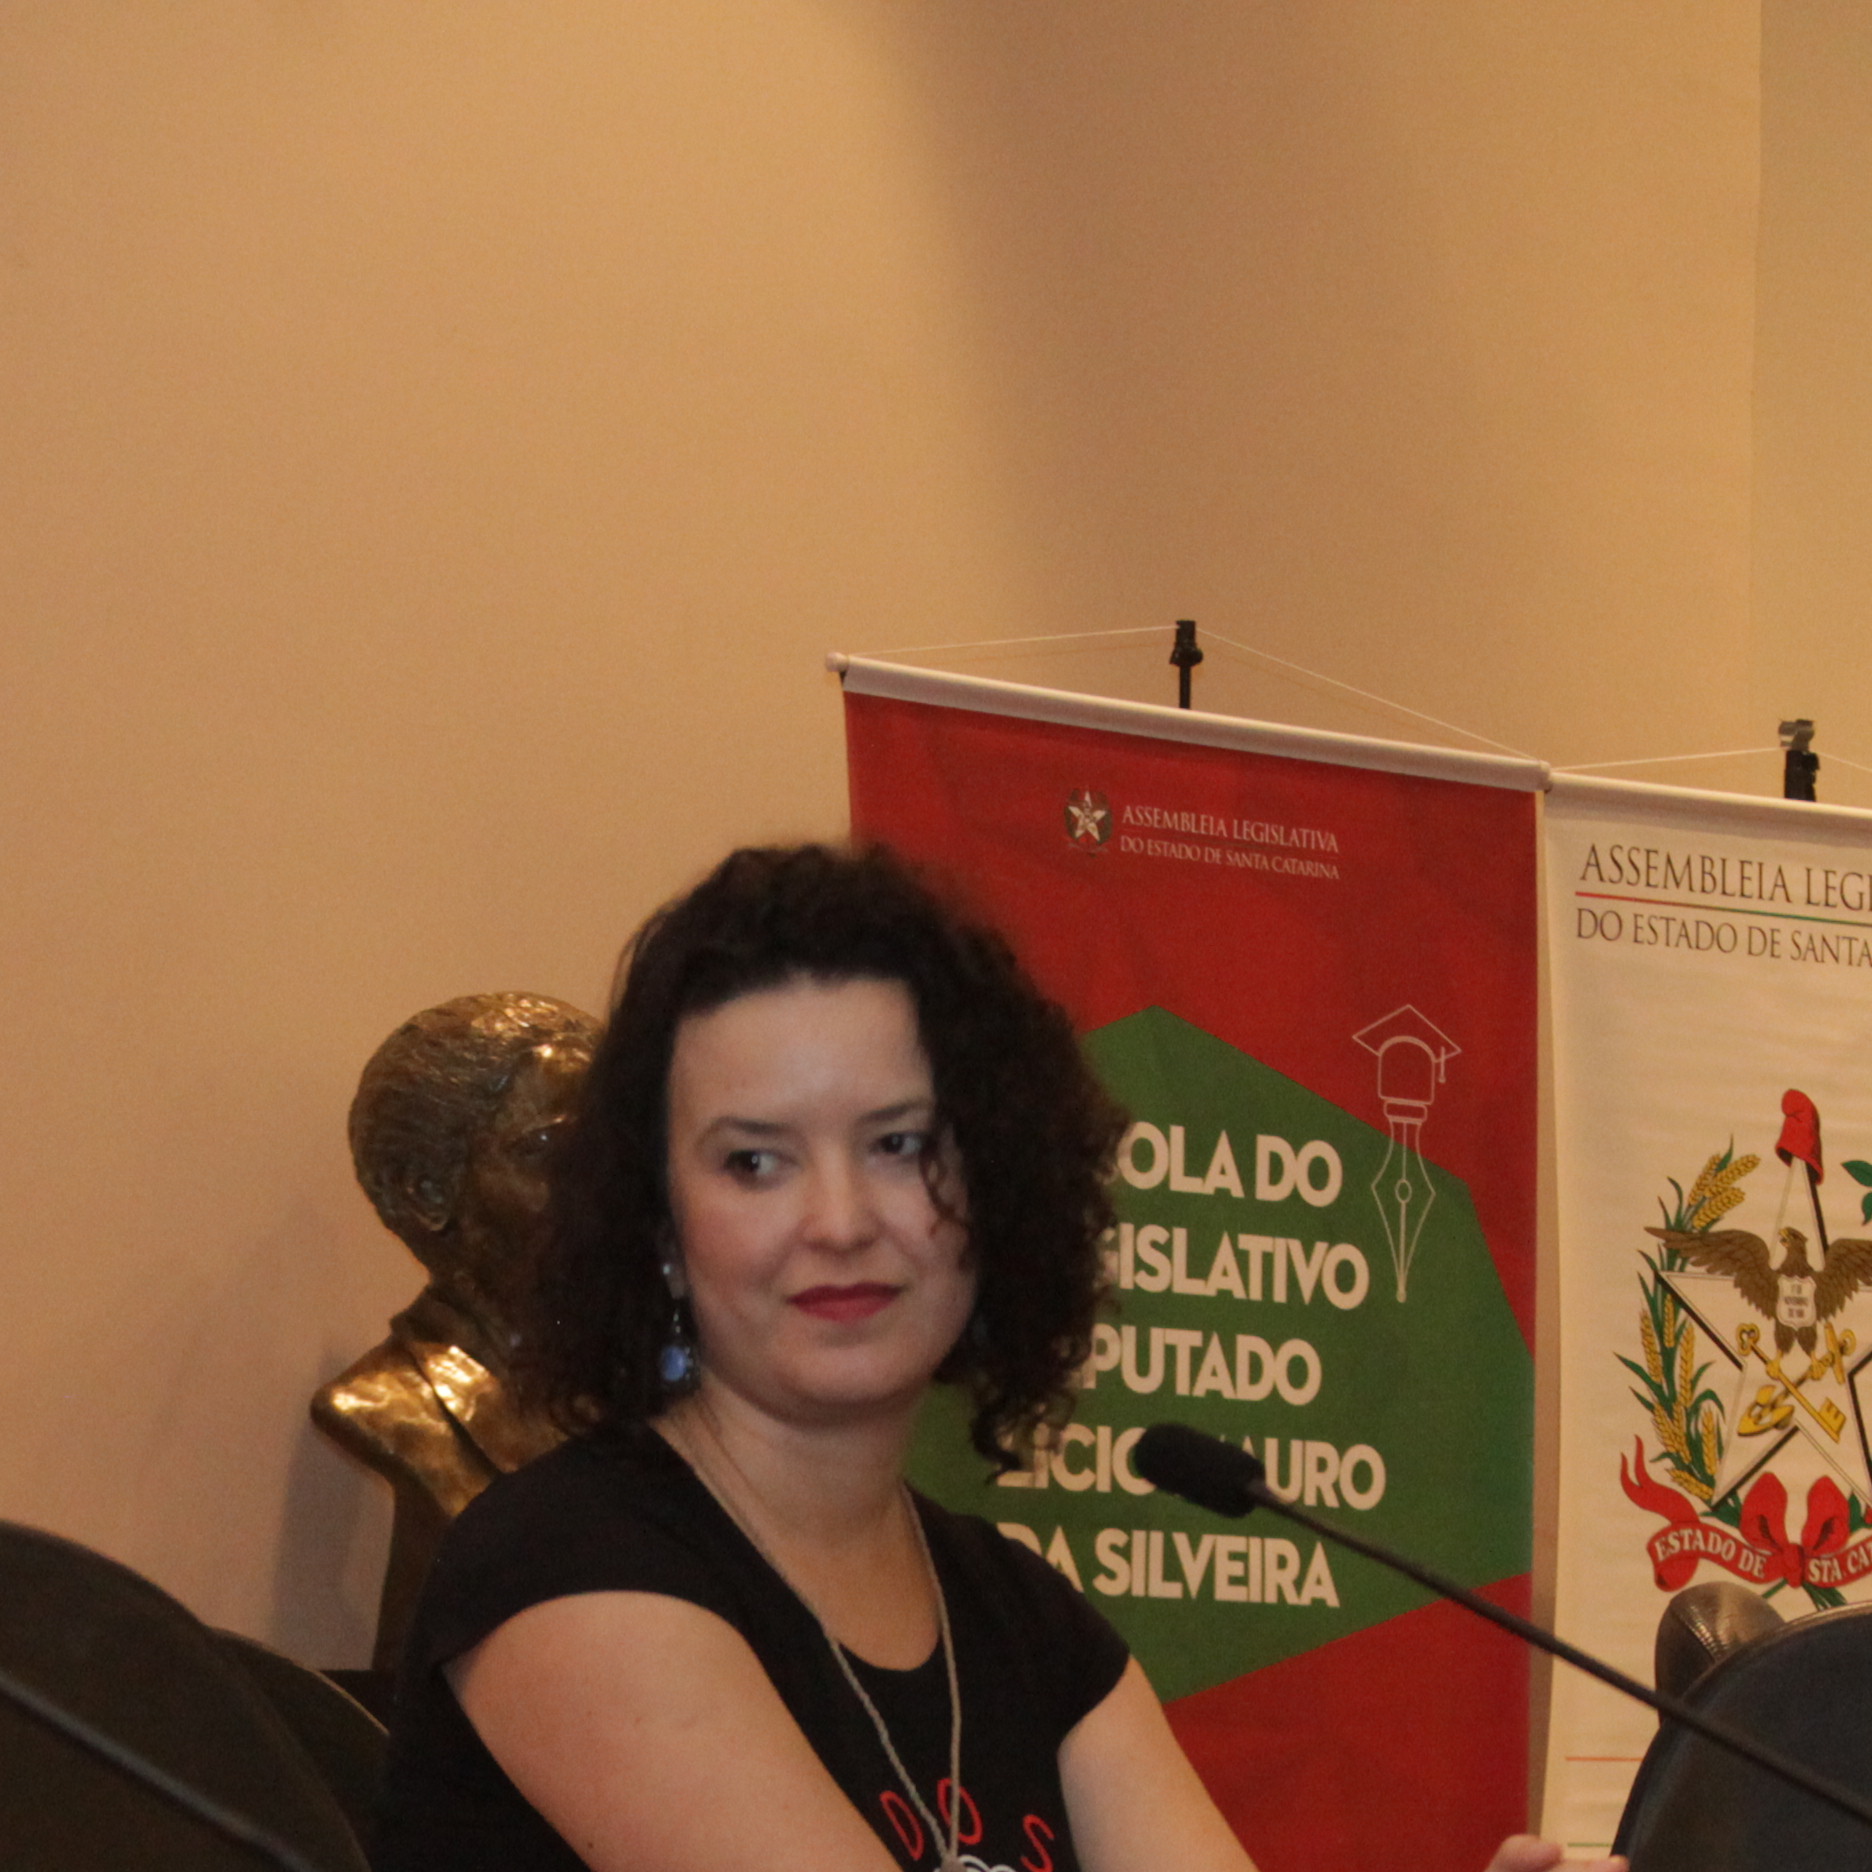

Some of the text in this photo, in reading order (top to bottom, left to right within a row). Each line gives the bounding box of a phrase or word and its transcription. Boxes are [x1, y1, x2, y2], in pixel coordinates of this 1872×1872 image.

[1120, 835, 1340, 880] DO ESTADO DE SANTA CATARINA
[1122, 805, 1339, 853] ASSEMBLEIA LEGISLATIVA
[1579, 843, 1791, 904] ASSEMBLEIA
[1576, 907, 1623, 943] DO
[1632, 914, 1738, 954] ESTADO
[1747, 925, 1782, 959] DE
[1100, 1121, 1344, 1207] OLA DO
[1096, 1221, 1370, 1310] ISLATIVO
[1074, 1322, 1322, 1406] PUTADO
[1092, 1527, 1341, 1608] SILVEIRA
[1654, 1529, 1737, 1562] ESTADO
[1737, 1551, 1767, 1579] DE
